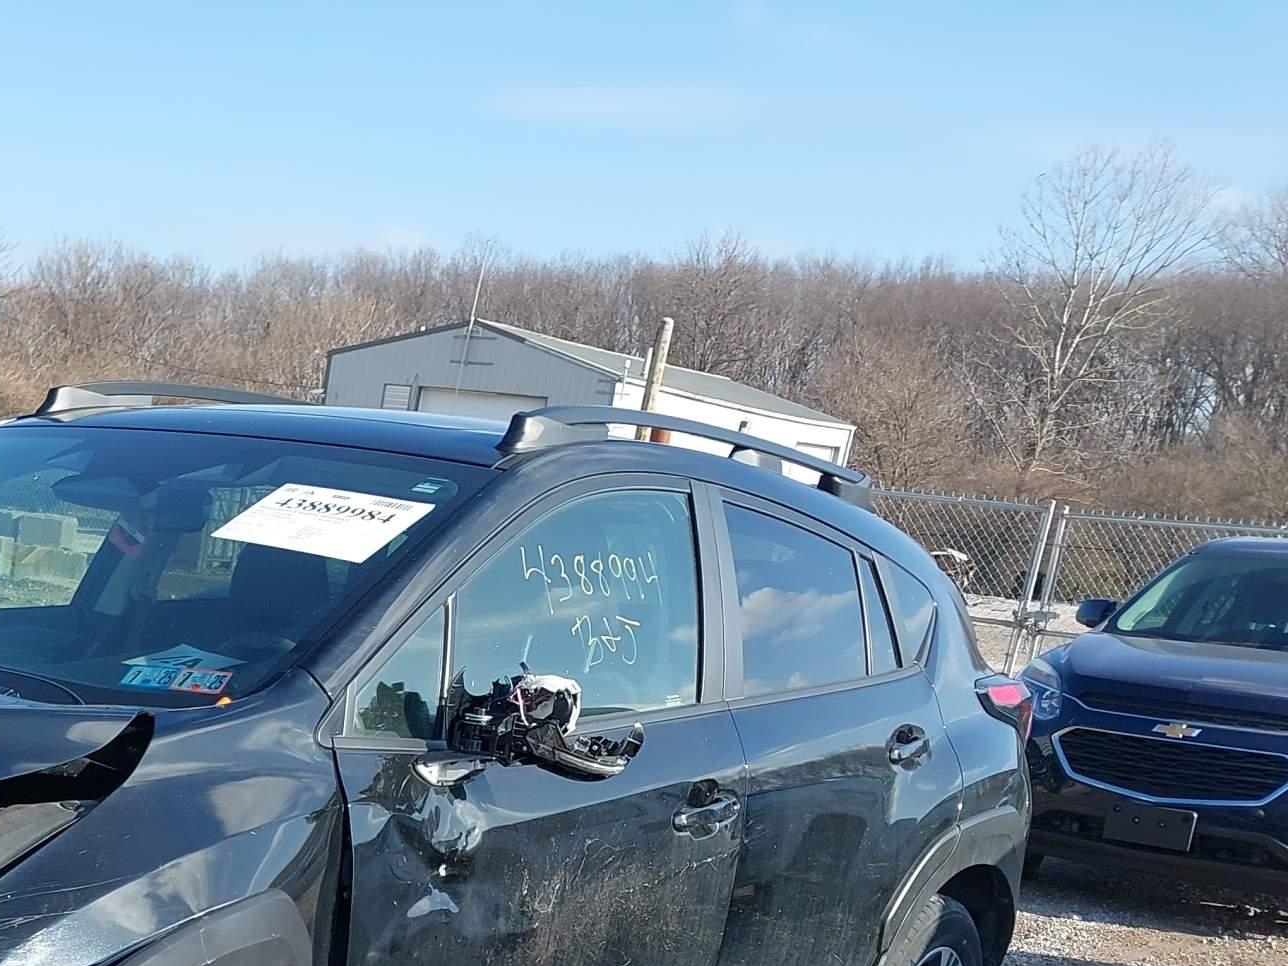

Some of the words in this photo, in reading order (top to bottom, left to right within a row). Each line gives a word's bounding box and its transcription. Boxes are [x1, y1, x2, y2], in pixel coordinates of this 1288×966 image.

[275, 498, 396, 523] 43889984
[128, 670, 143, 684] 7
[157, 670, 177, 685] 25
[177, 671, 194, 687] 7
[208, 674, 228, 690] 25
